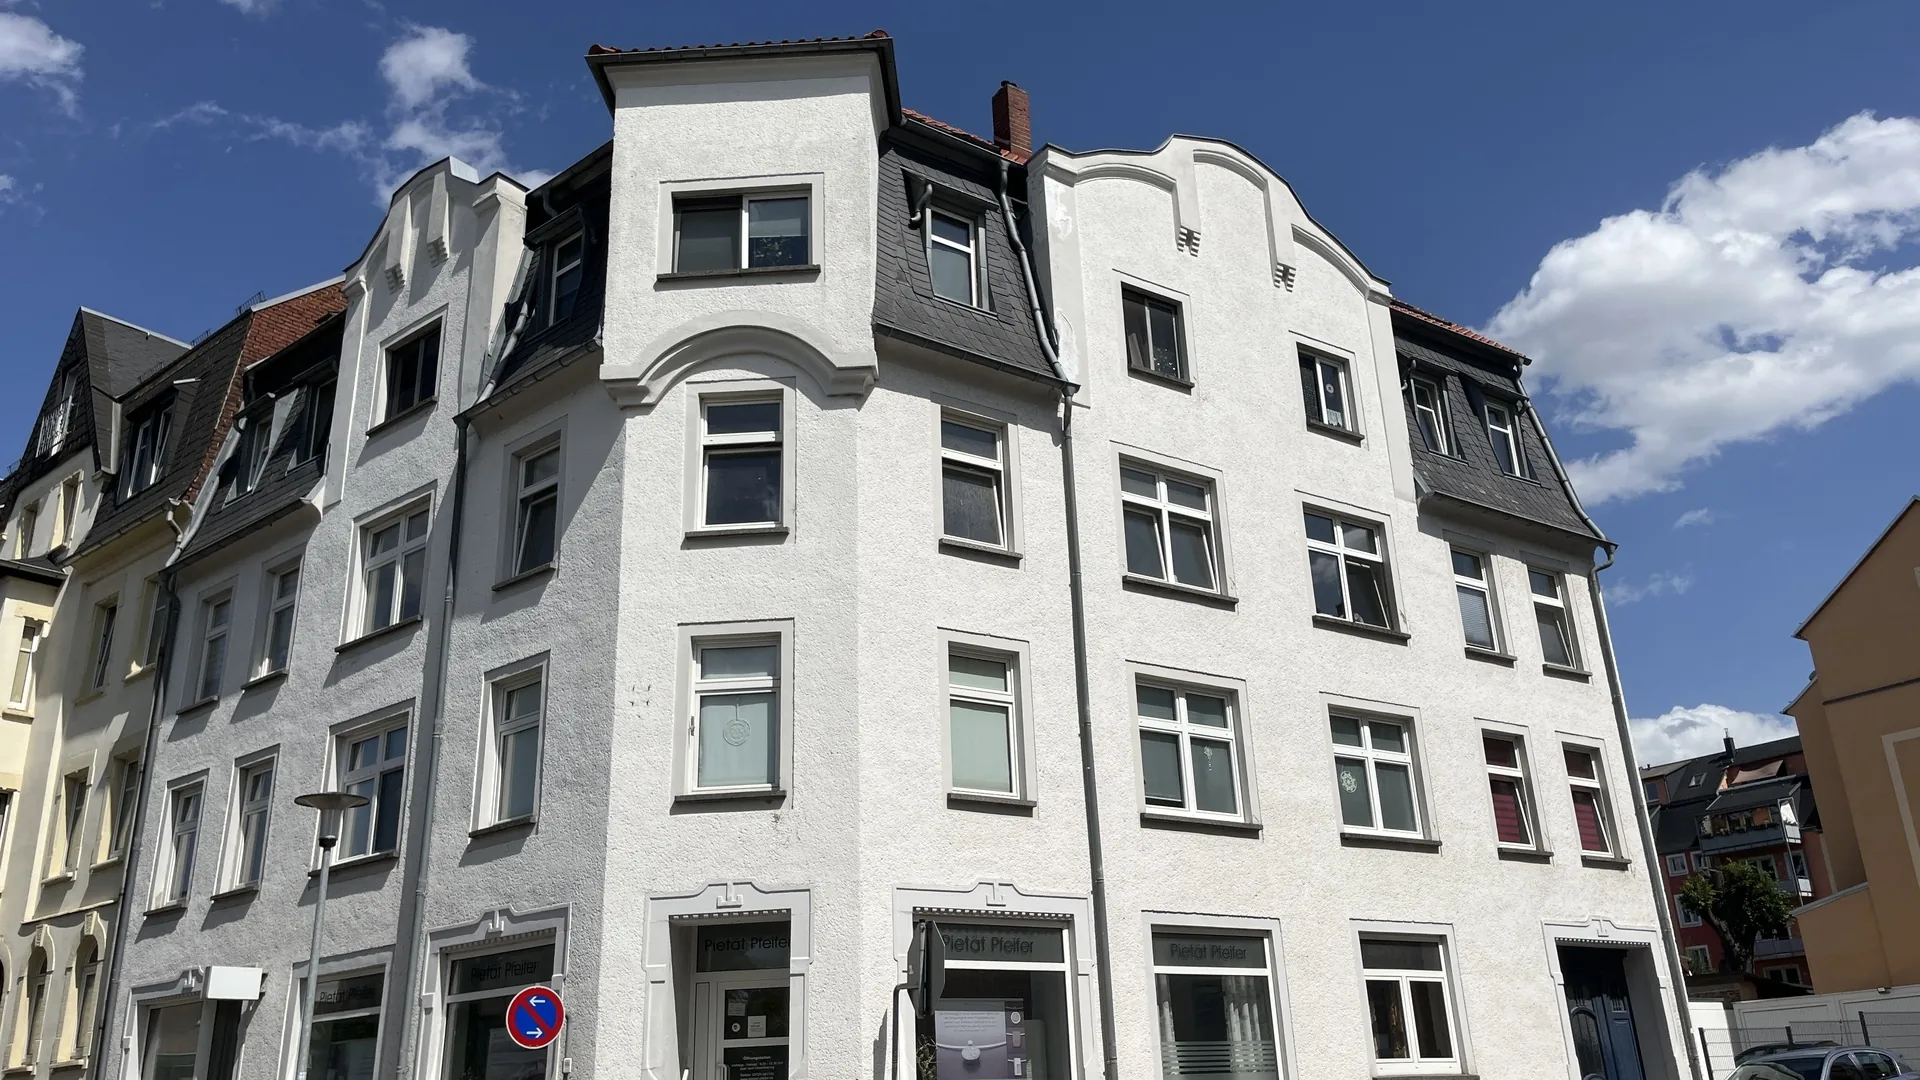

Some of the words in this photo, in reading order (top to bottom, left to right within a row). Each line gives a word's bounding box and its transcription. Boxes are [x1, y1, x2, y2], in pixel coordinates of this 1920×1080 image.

[704, 937, 746, 951] Pietät
[942, 934, 986, 953] Pietät
[991, 936, 1034, 954] Pfeifer
[1170, 943, 1207, 960] Pietät
[1211, 944, 1247, 960] Pfeifer
[504, 960, 538, 977] Pfeifer
